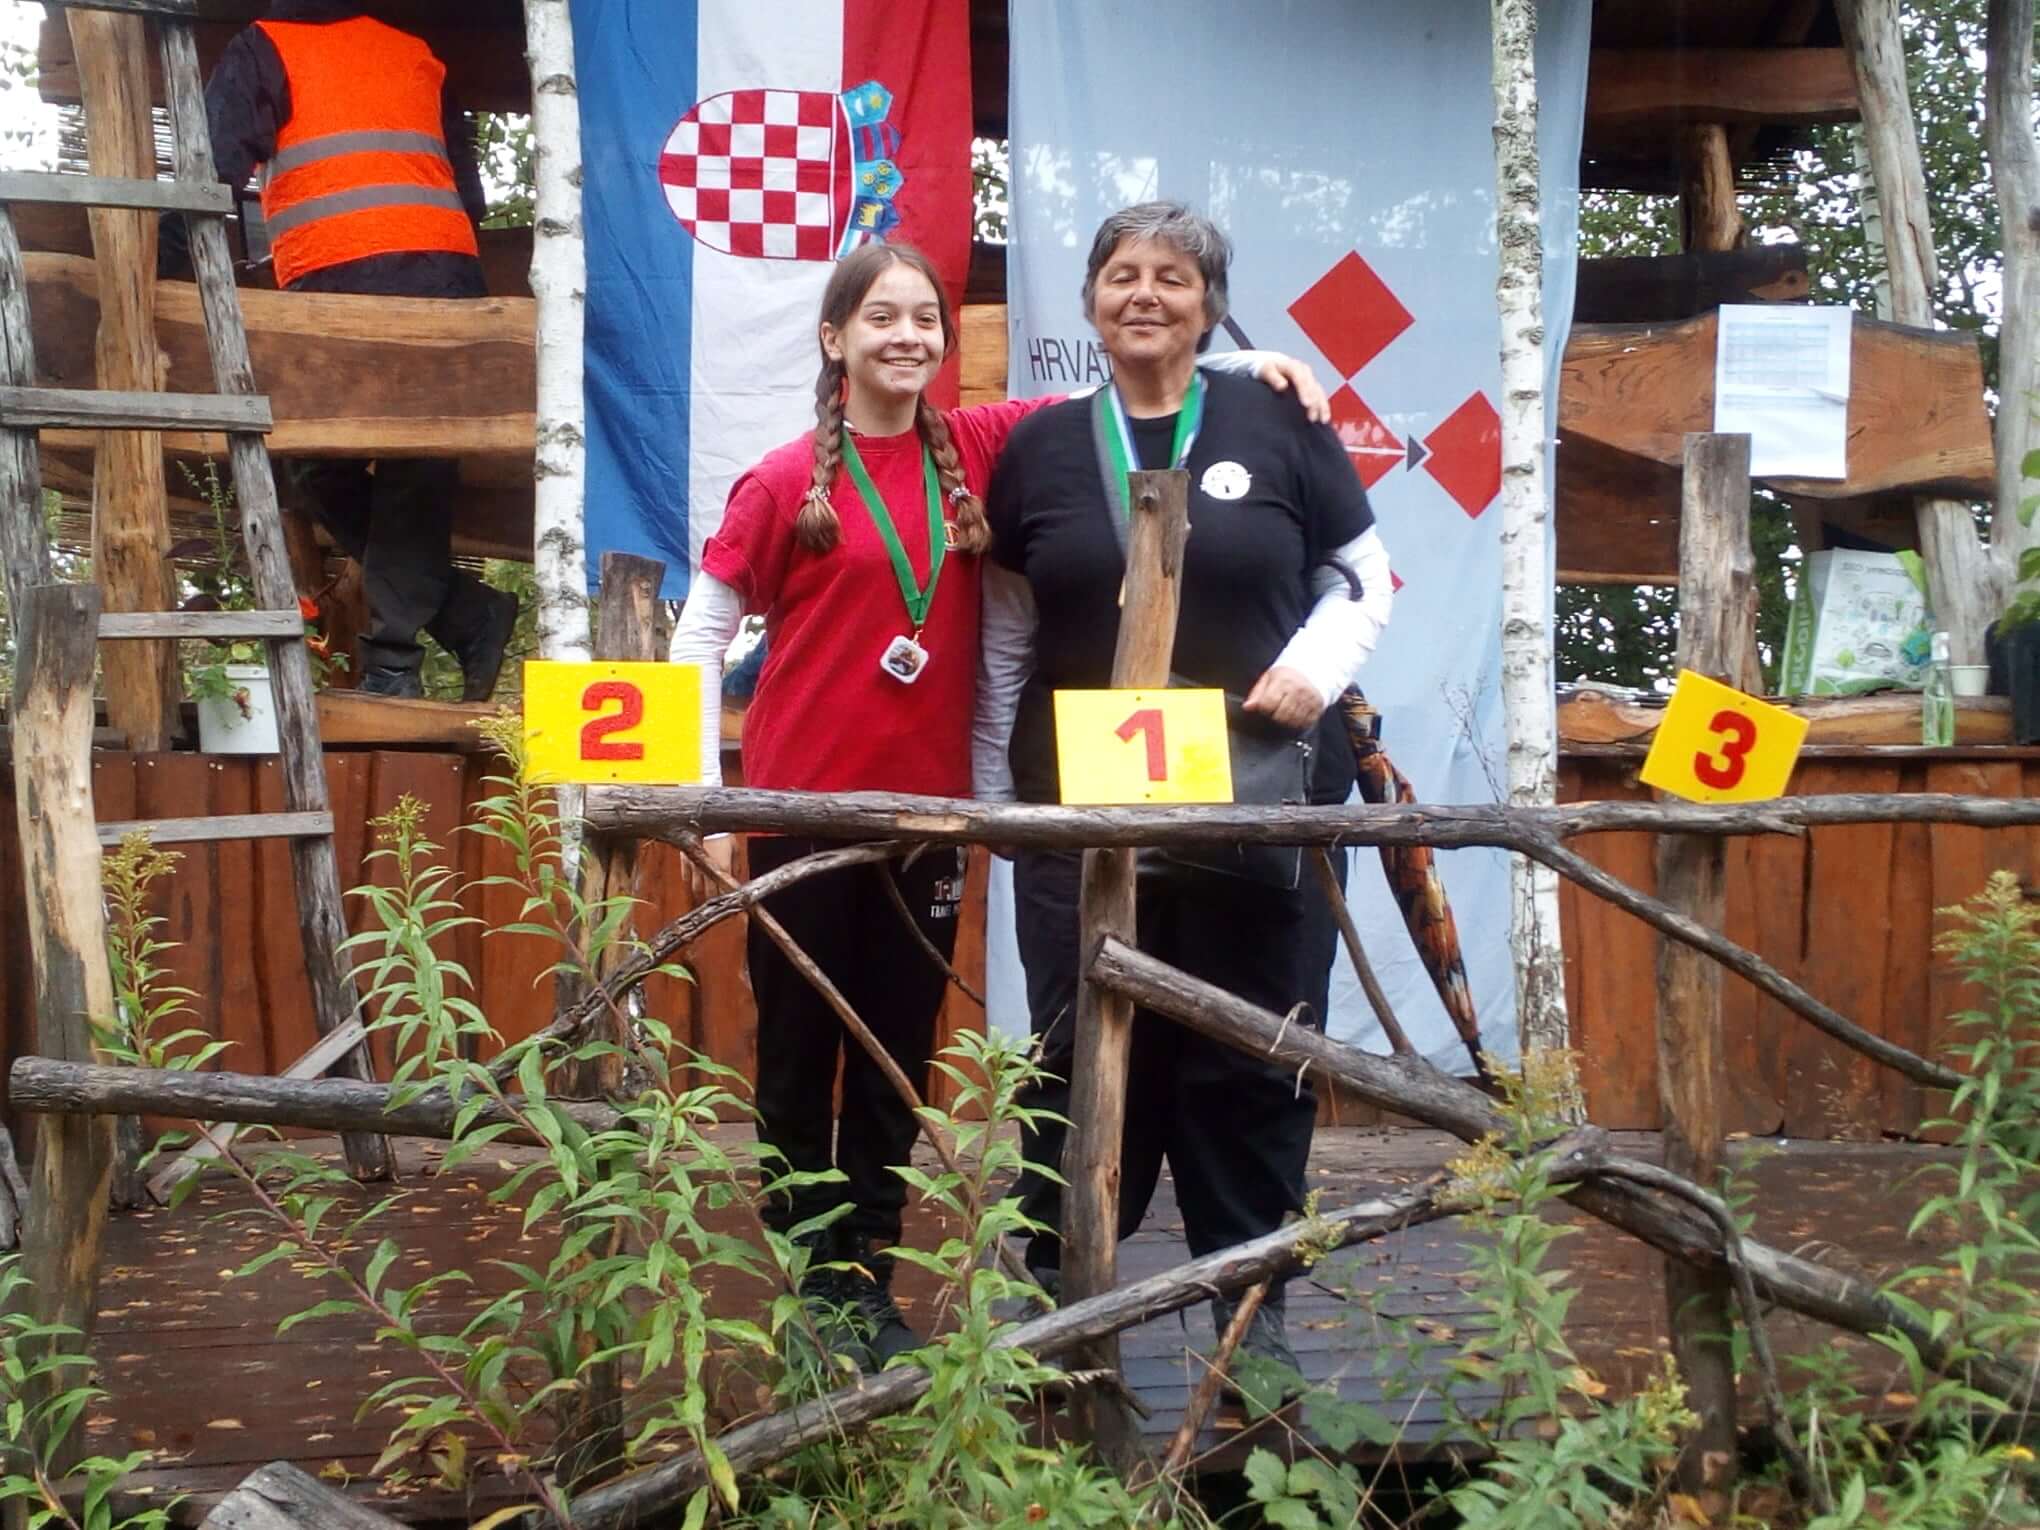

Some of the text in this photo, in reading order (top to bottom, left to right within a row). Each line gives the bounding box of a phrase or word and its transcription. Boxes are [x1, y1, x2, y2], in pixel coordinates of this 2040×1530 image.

[580, 681, 644, 761] 2
[1114, 709, 1168, 782] 1
[1694, 709, 1757, 790] 3
